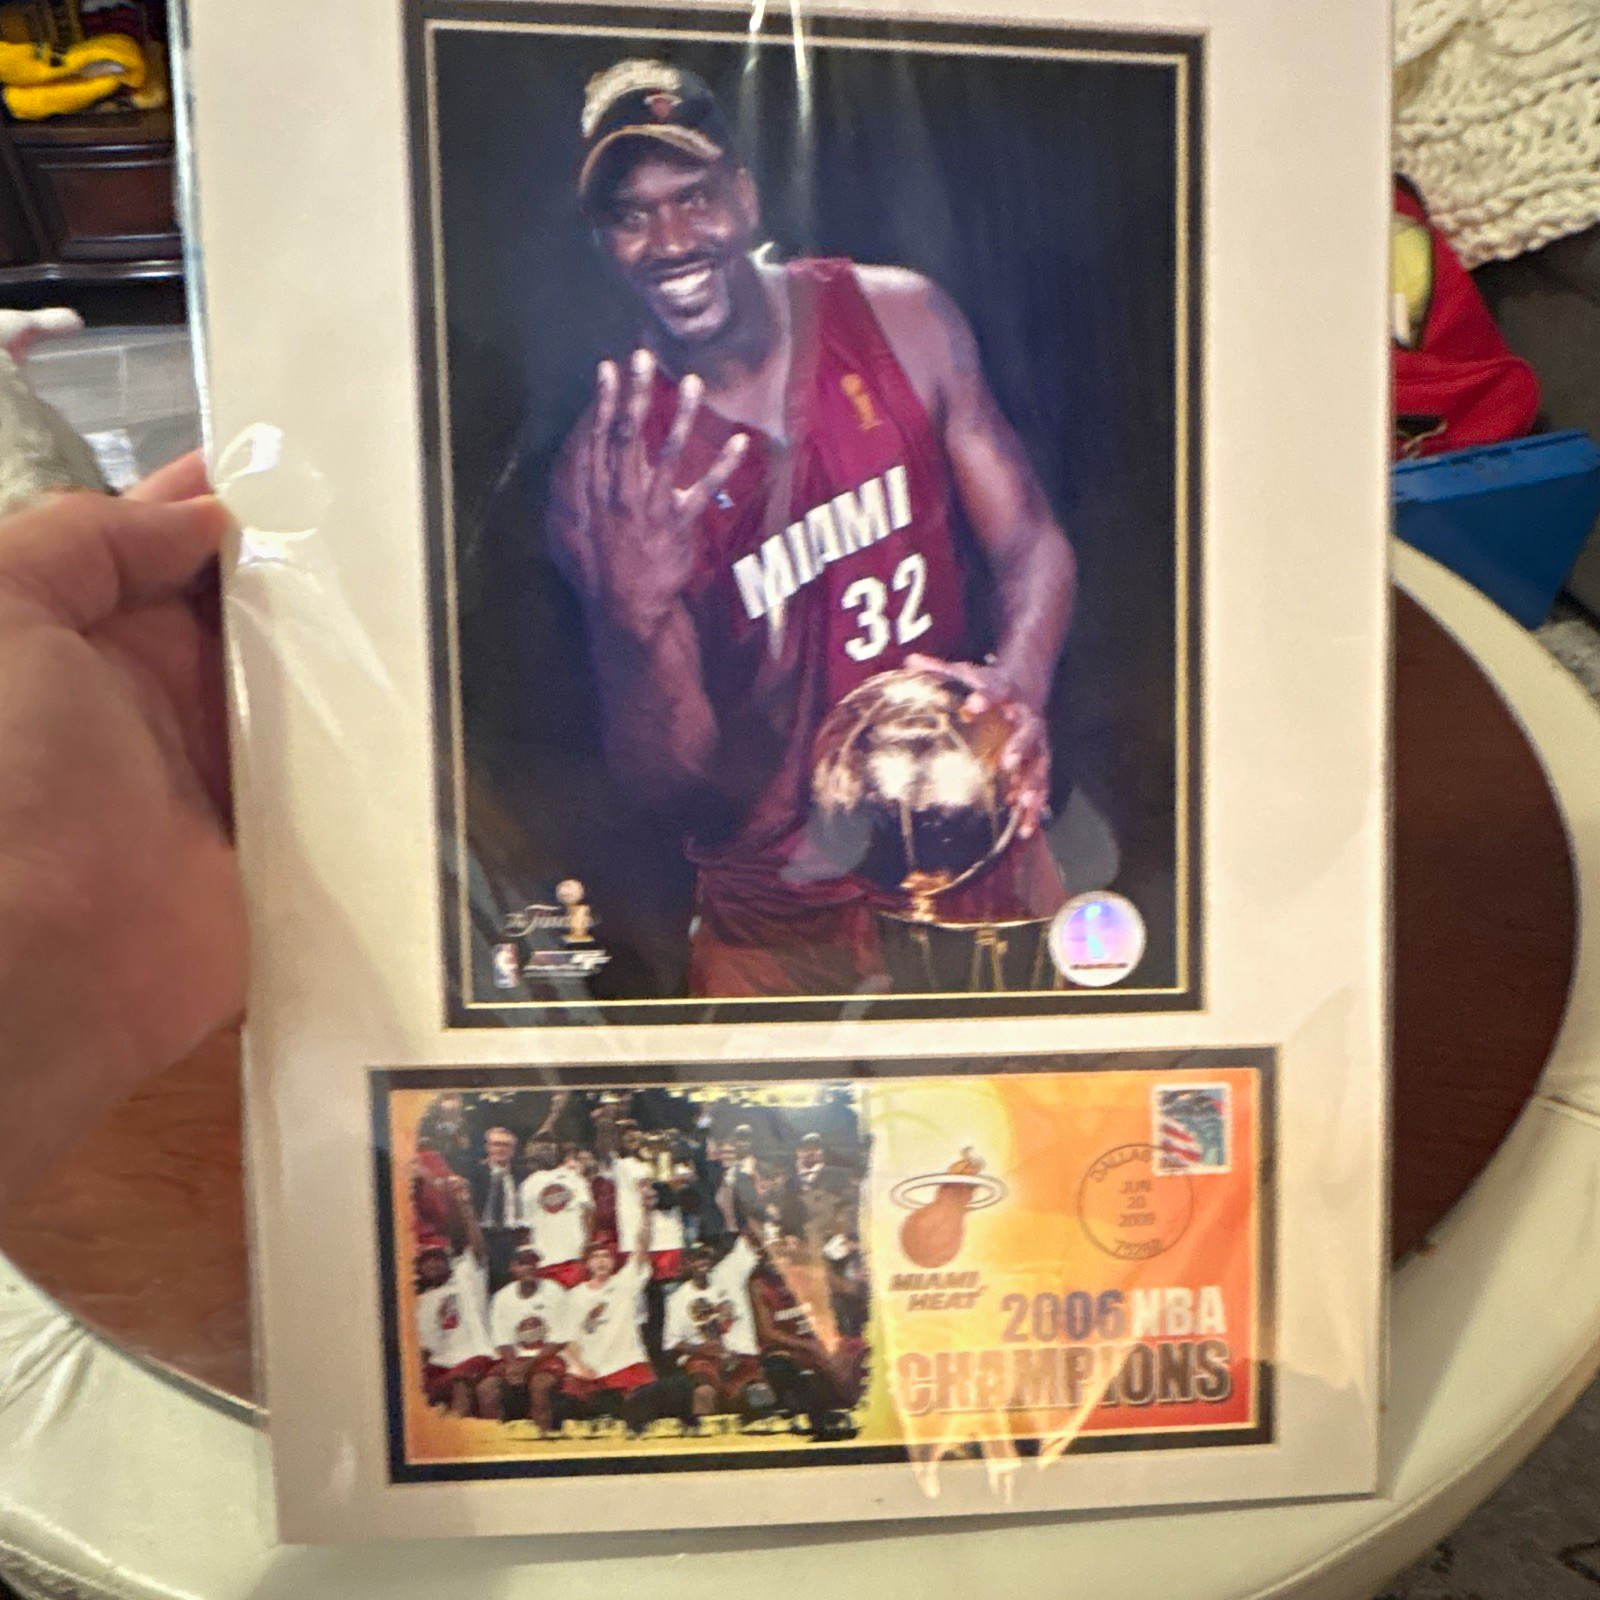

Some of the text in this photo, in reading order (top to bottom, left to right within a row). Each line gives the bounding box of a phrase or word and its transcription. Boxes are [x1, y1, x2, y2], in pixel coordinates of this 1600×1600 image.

[732, 465, 913, 619] MIAMI
[841, 553, 932, 661] 32
[888, 1271, 981, 1292] MIAMI
[905, 1285, 988, 1311] HEAT
[1000, 1286, 1227, 1342] 2006 NBA
[897, 1340, 1233, 1417] CHAMPIONS
